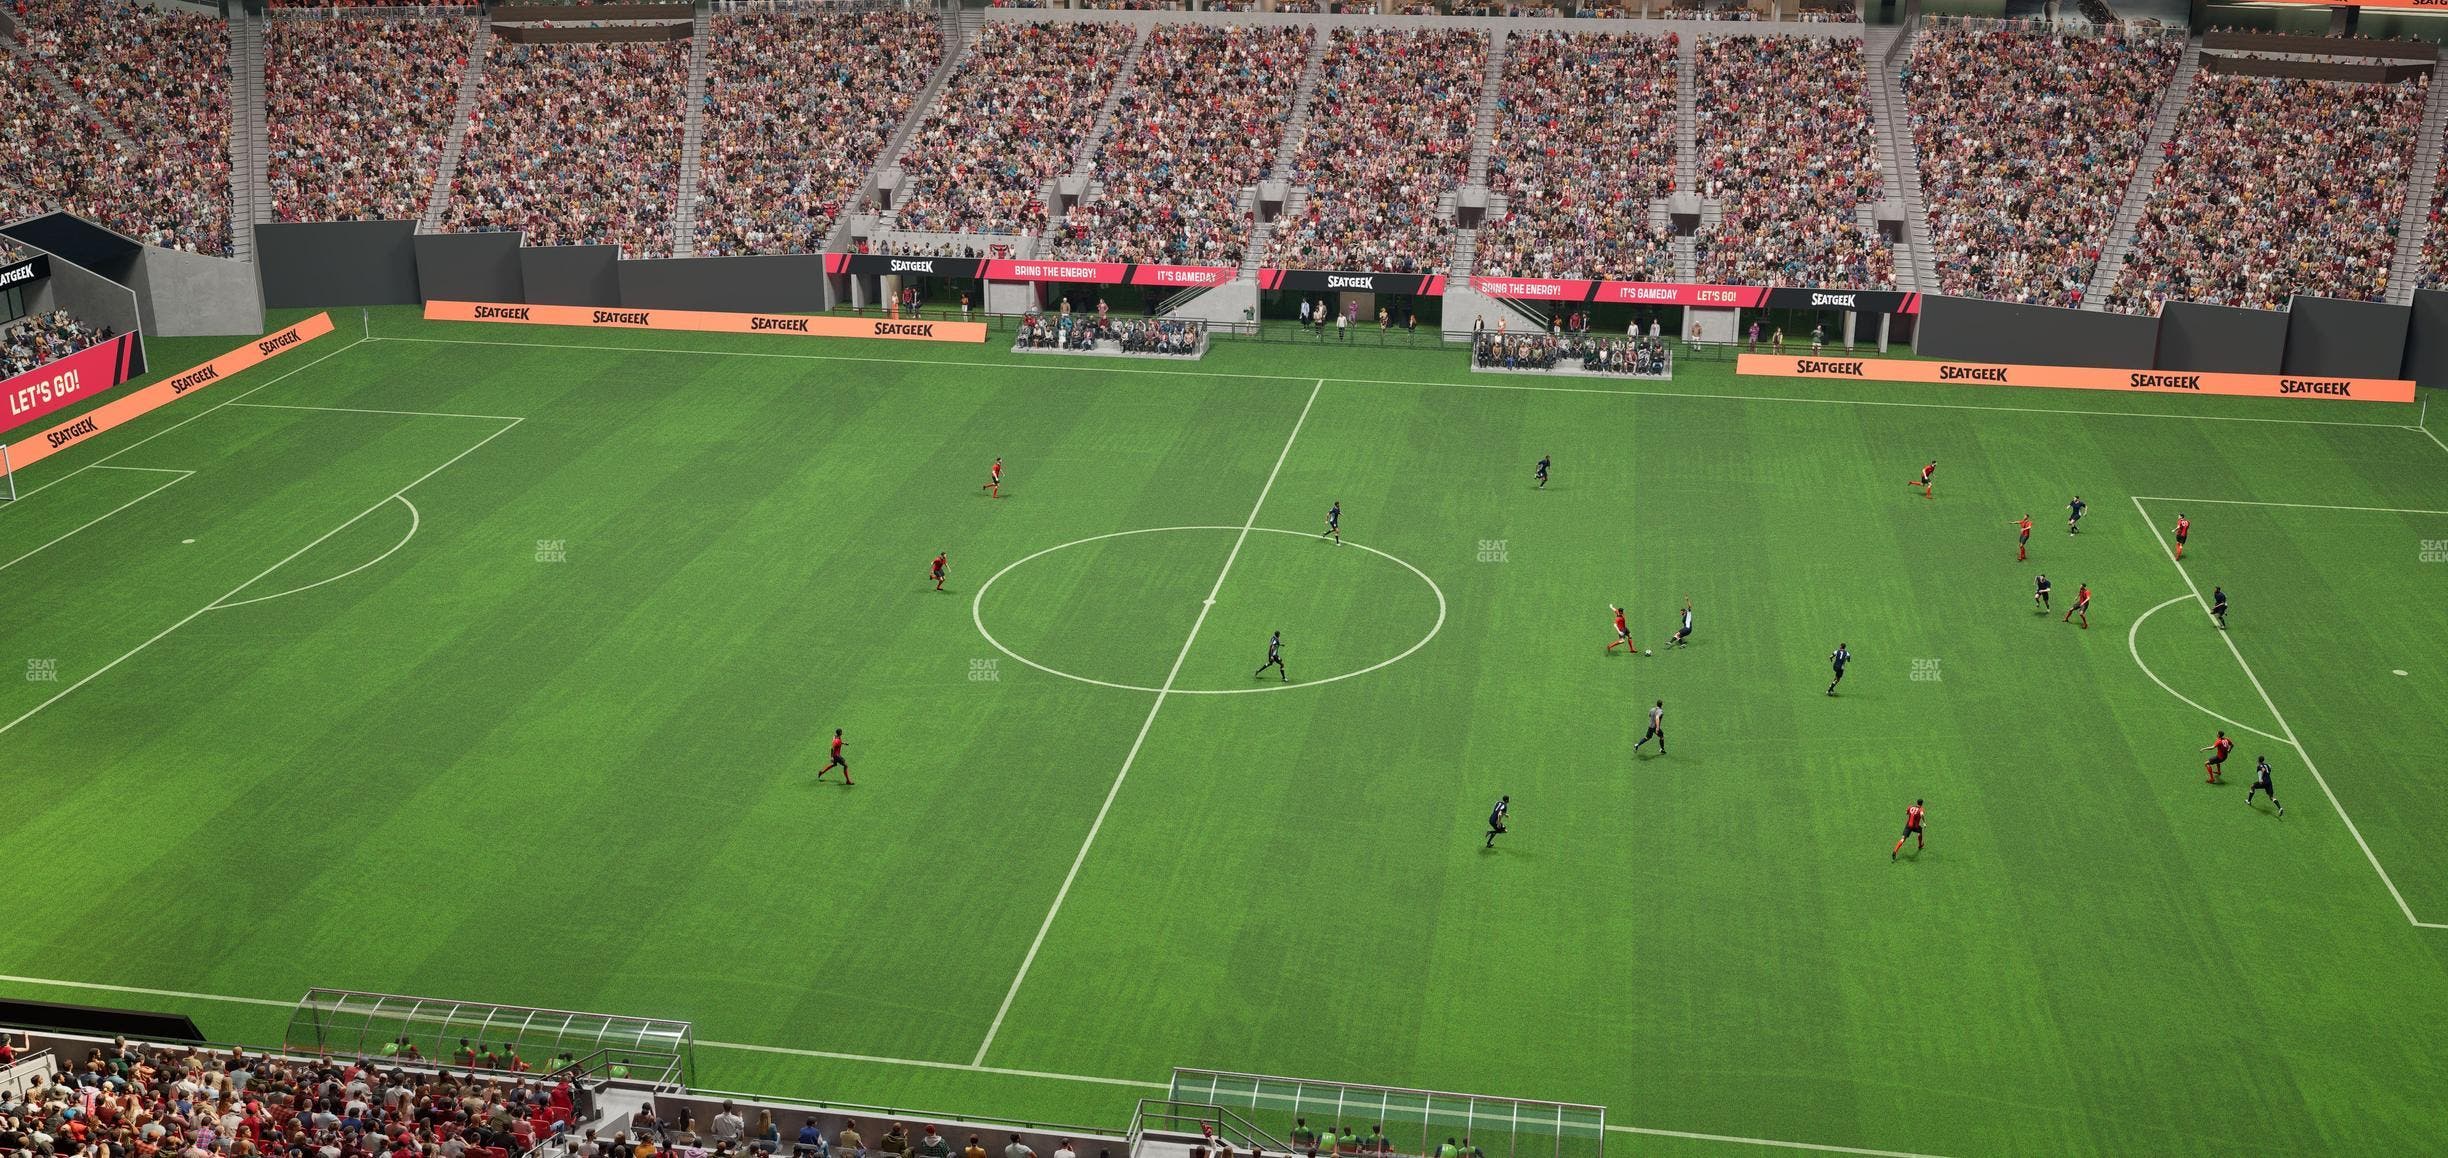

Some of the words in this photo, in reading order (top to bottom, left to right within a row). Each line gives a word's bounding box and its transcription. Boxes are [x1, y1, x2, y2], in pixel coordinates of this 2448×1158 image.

[890, 260, 934, 273] SEATGEEK
[1014, 265, 1041, 276] BRING
[1043, 266, 1059, 277] THE
[1060, 267, 1097, 279] ENERGY!
[1157, 270, 1174, 281] IT'S
[1175, 271, 1217, 283] GAMEDAY
[1327, 276, 1373, 290] SEATGEEK
[1481, 282, 1507, 293] BRING
[1508, 283, 1525, 294] THE
[1525, 284, 1561, 296] ENERGY!
[1619, 287, 1636, 299] IT'S
[1637, 288, 1678, 300] GAMEDAY
[1697, 290, 1720, 301] LET'S
[1721, 291, 1737, 302] GO!
[1811, 292, 1857, 308] SEATGEEK
[475, 306, 529, 320] SEATGEEK
[593, 311, 649, 325] SEATGEEK
[751, 317, 808, 332] SEATGEEK
[875, 322, 933, 337] SEATGEEK
[259, 328, 302, 356] SEATGEEK
[1797, 360, 1864, 377] SEATGEEK
[1940, 366, 2007, 383] SEATGEEK
[171, 365, 219, 395] SEATGEEK
[2131, 373, 2201, 391] SEATGEEK
[10, 380, 51, 416] LET'S
[54, 369, 80, 400] GO!
[2280, 380, 2351, 397] SEATGEEK
[47, 416, 99, 449] SEATGEEK
